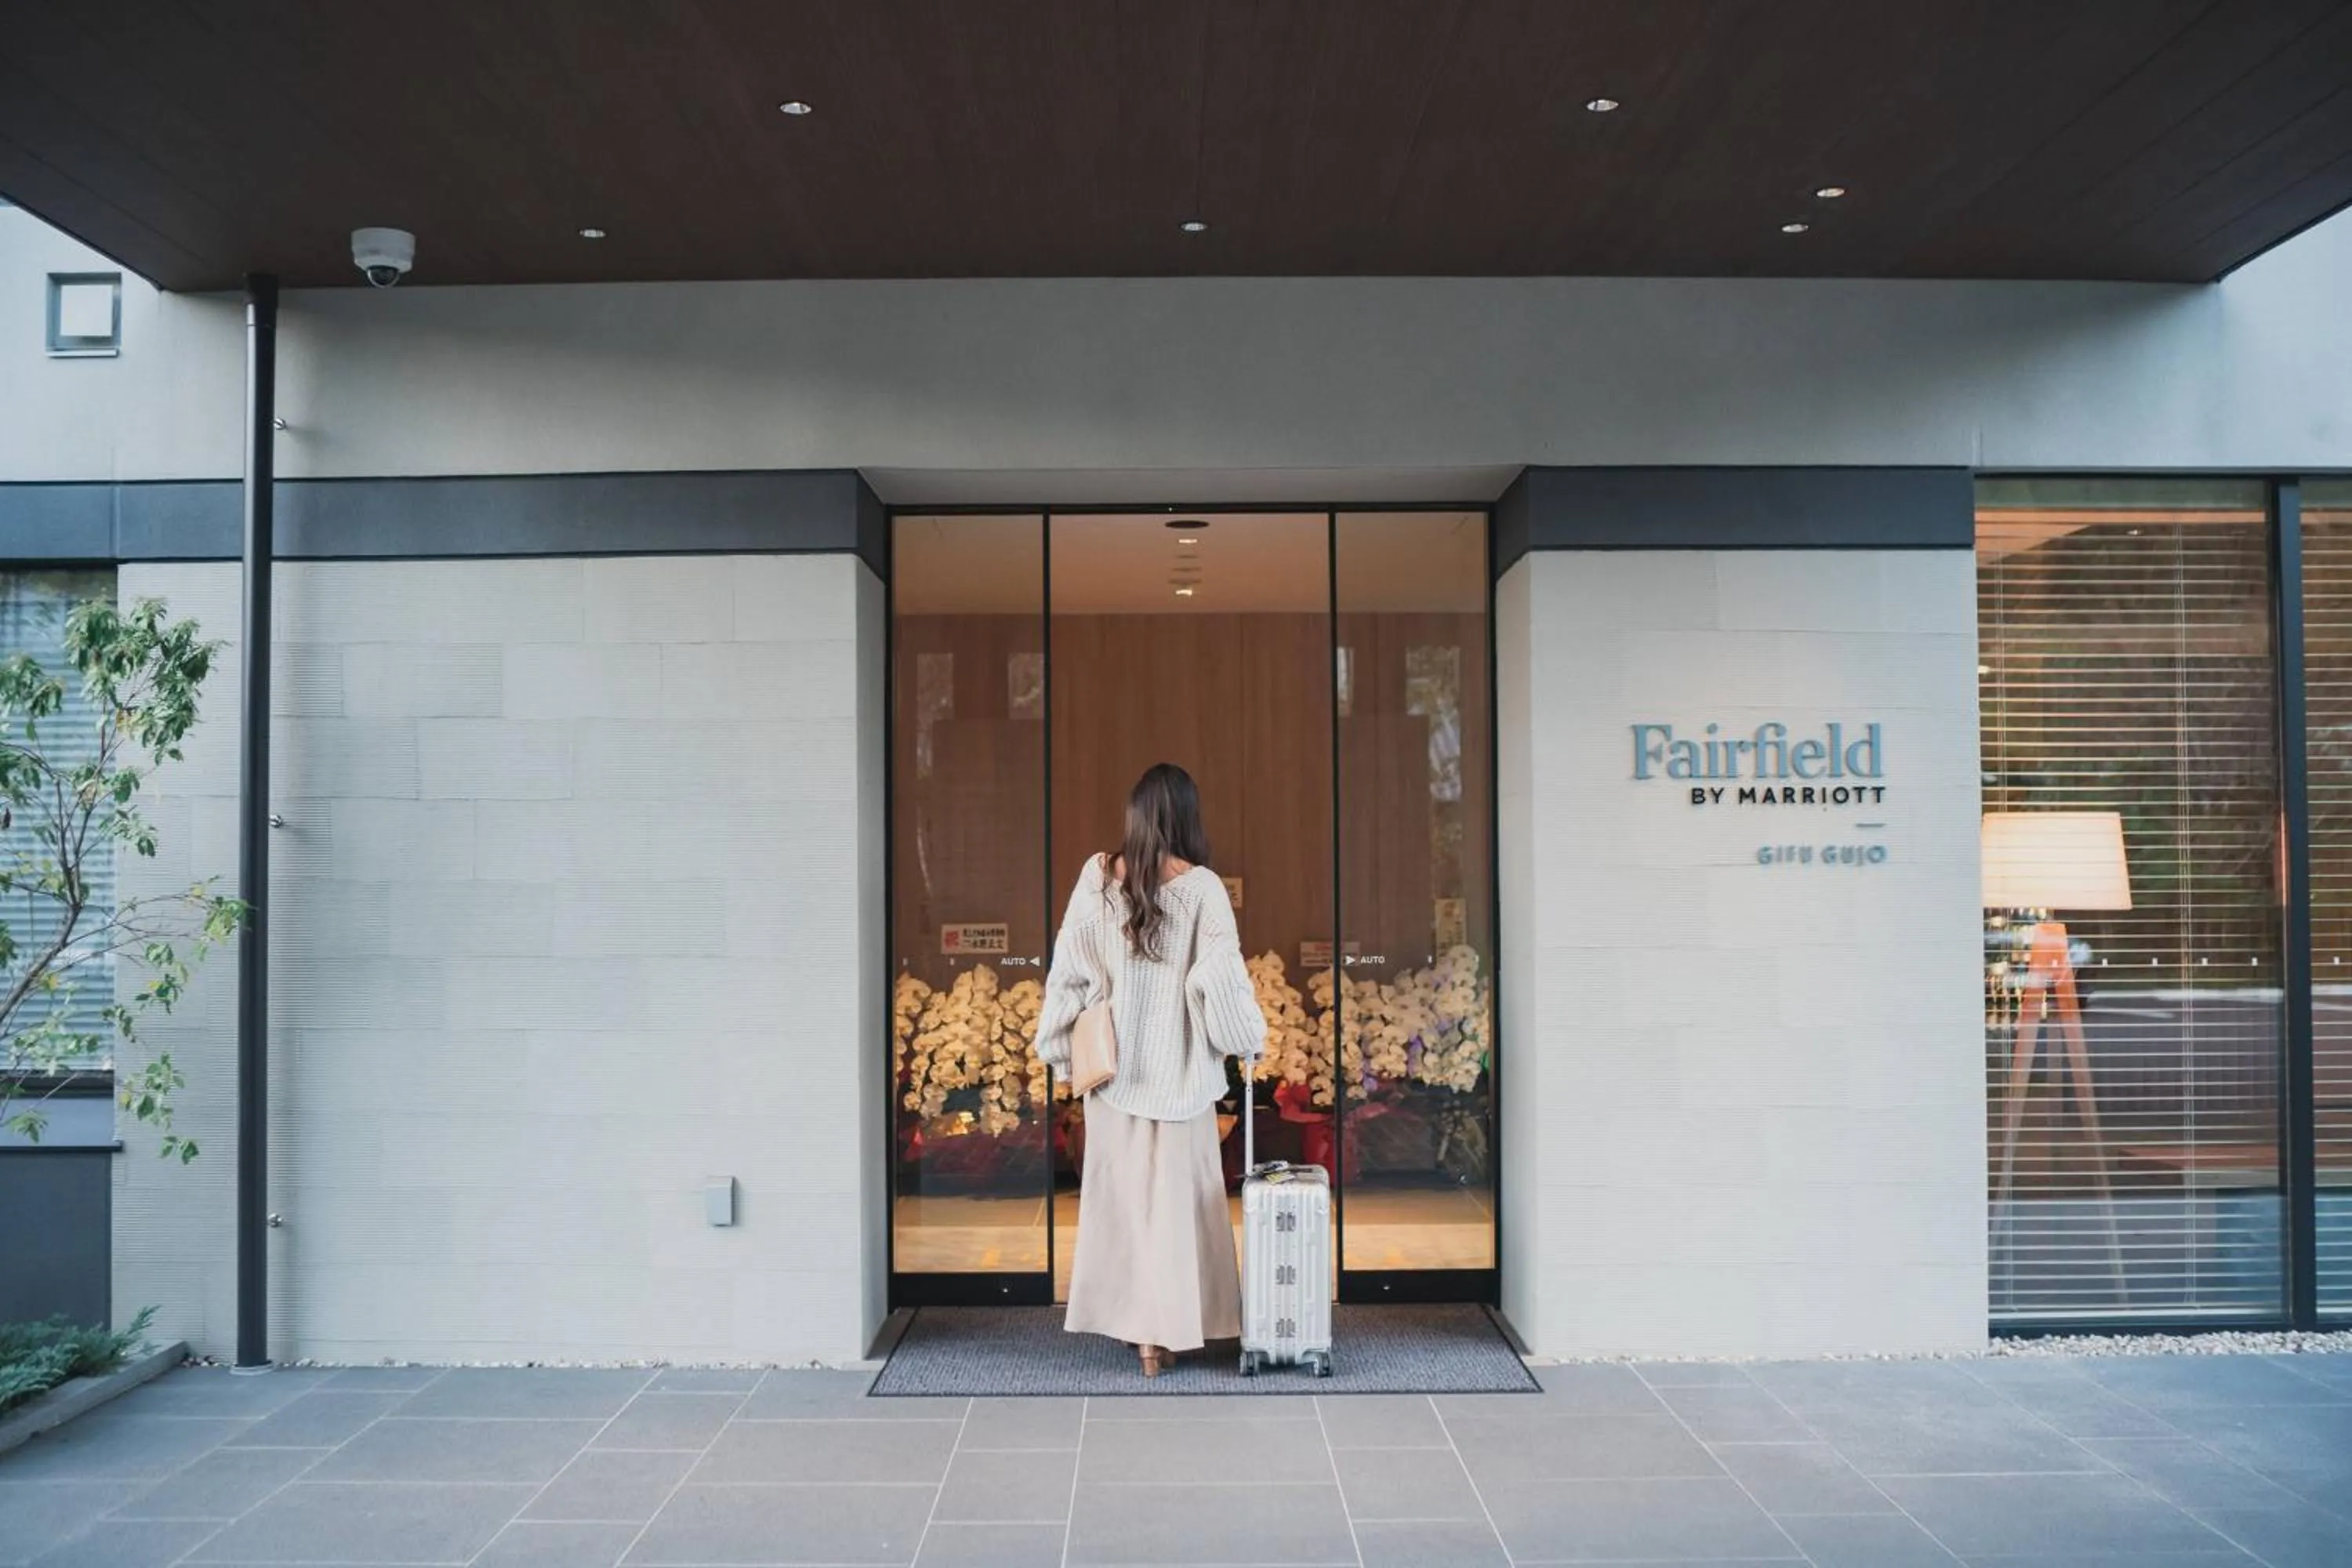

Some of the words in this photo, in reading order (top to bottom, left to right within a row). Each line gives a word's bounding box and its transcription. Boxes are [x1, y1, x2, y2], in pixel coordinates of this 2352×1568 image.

[1630, 722, 1884, 780] Fairfield
[1691, 786, 1725, 804] BY
[1738, 786, 1886, 804] MARRIOTT
[1757, 845, 1813, 864] GIFU
[1000, 957, 1027, 966] AUTO
[1360, 956, 1385, 964] AUTO
